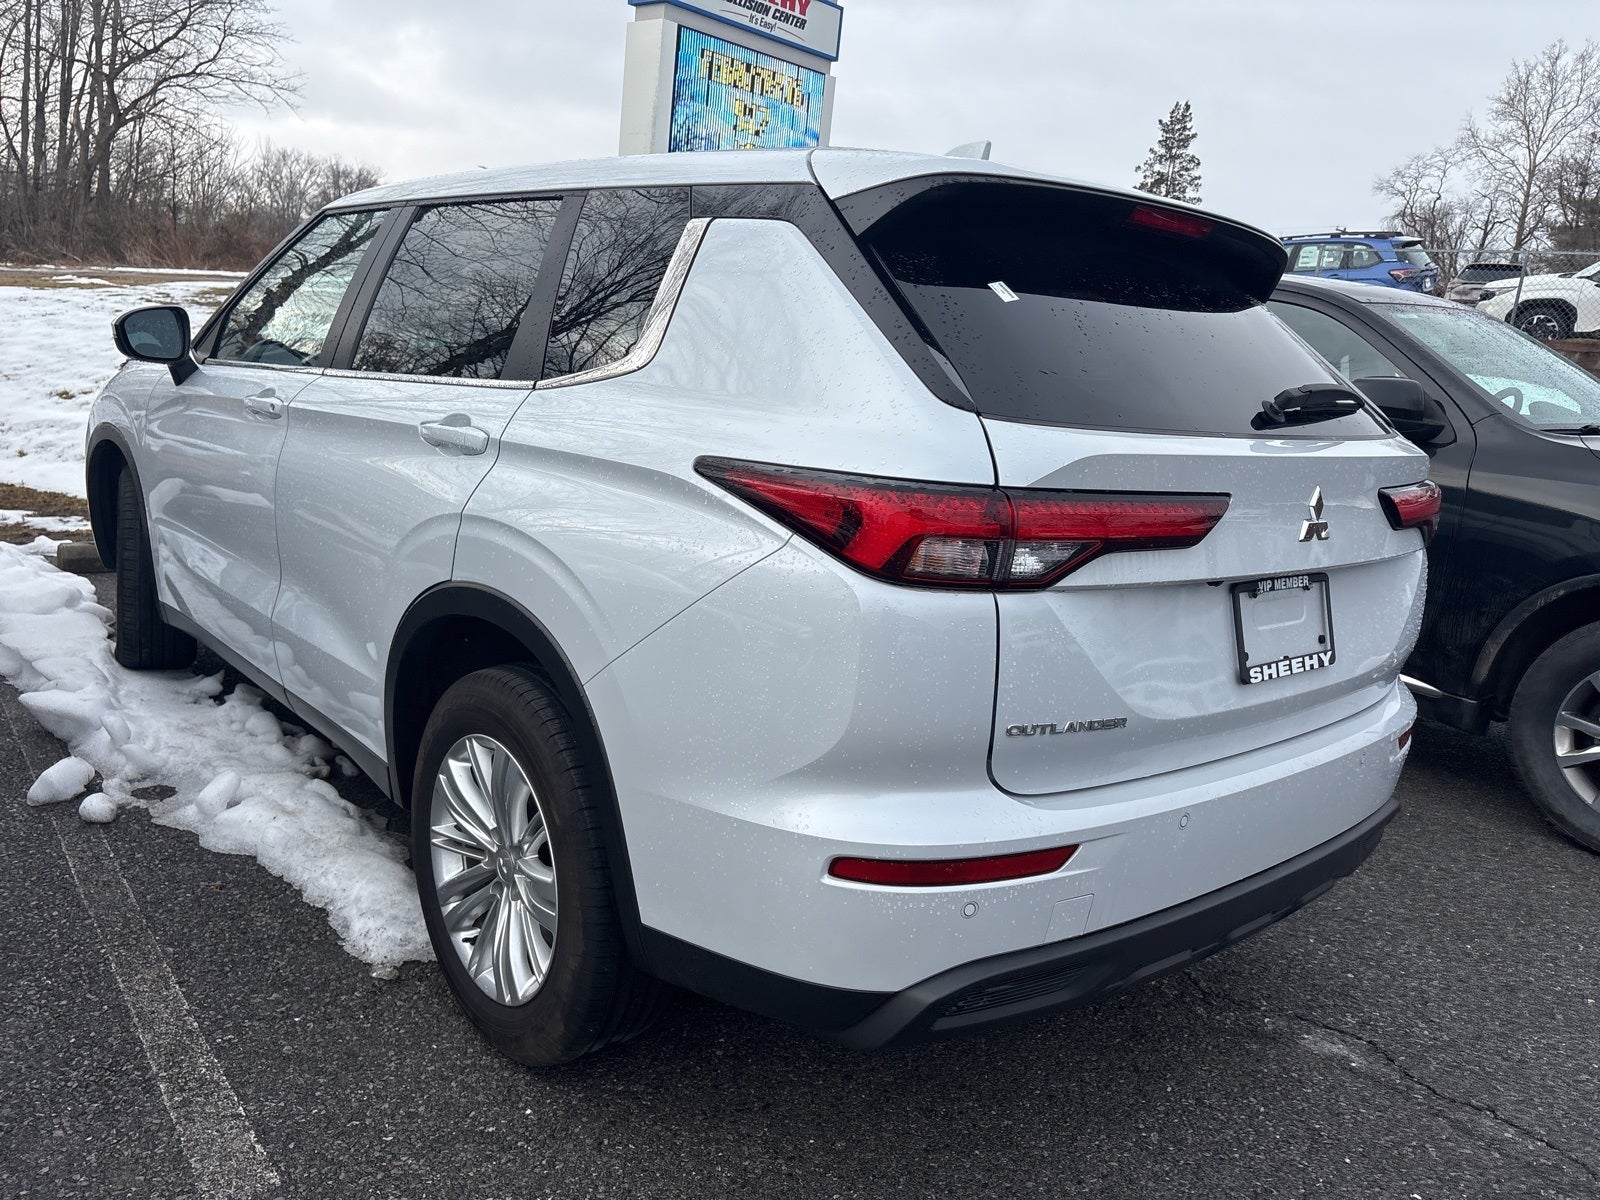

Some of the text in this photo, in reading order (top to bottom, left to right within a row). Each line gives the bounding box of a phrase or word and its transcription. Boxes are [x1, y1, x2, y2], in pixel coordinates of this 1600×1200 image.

[749, 13, 777, 32] It's Easy!
[772, 10, 807, 30] CENTER
[1258, 576, 1309, 592] VIP MEMBER
[1249, 651, 1332, 684] SHEEHY
[1006, 717, 1128, 737] OUTLANDER
